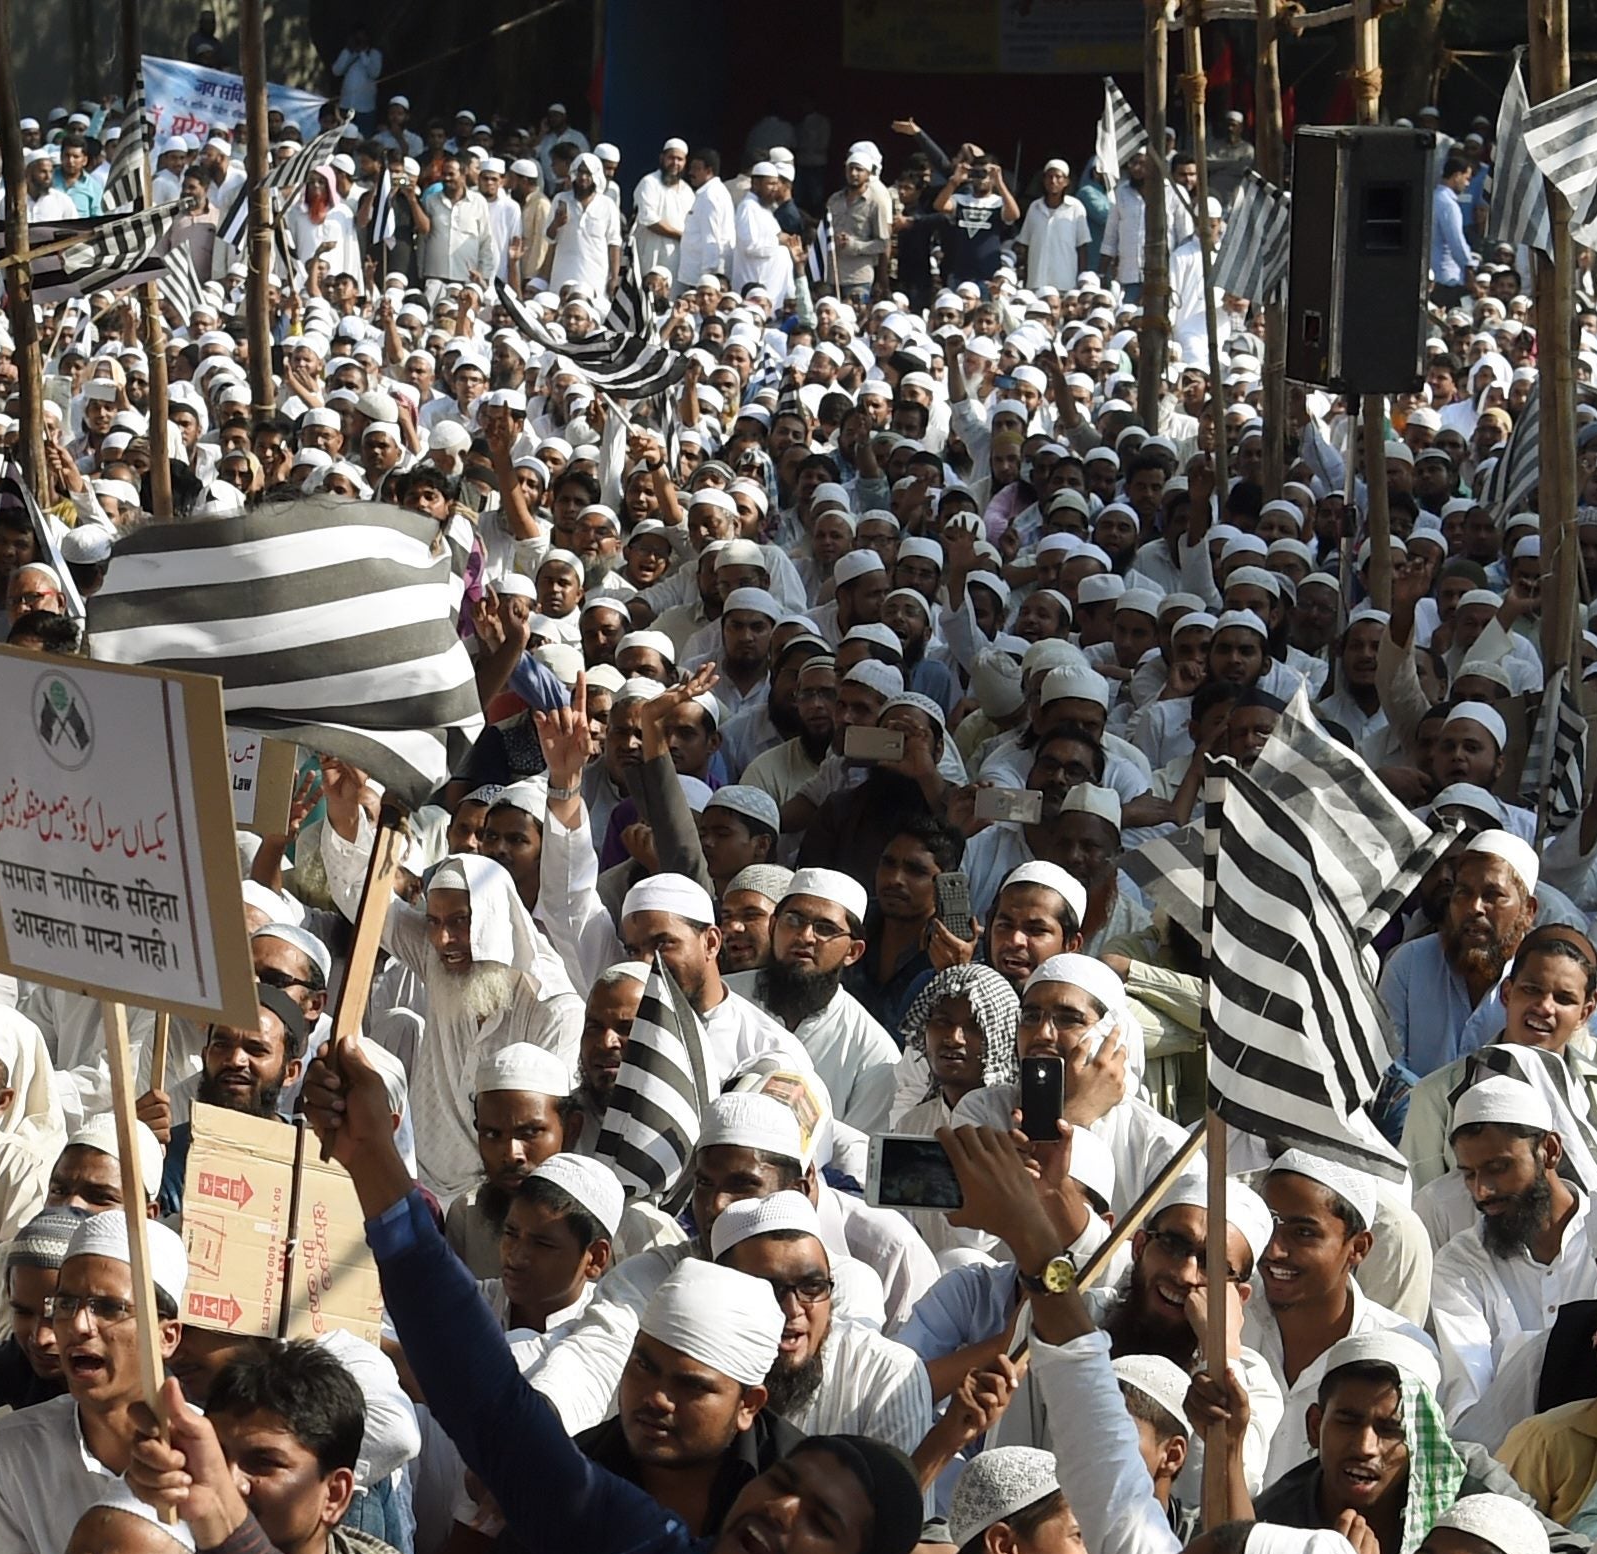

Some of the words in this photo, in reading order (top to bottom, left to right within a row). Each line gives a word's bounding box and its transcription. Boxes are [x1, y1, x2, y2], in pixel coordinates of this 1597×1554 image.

[232, 774, 253, 791] Law
[50, 867, 120, 911] नागरिक
[122, 877, 179, 925] संहिता
[11, 907, 78, 950] आम्हाला
[81, 924, 125, 960] मान्य
[267, 1246, 276, 1267] 600
[302, 1240, 316, 1270] in
[312, 1201, 333, 1291] three
[261, 1268, 274, 1332] PACKETS
[307, 1273, 323, 1333] one
